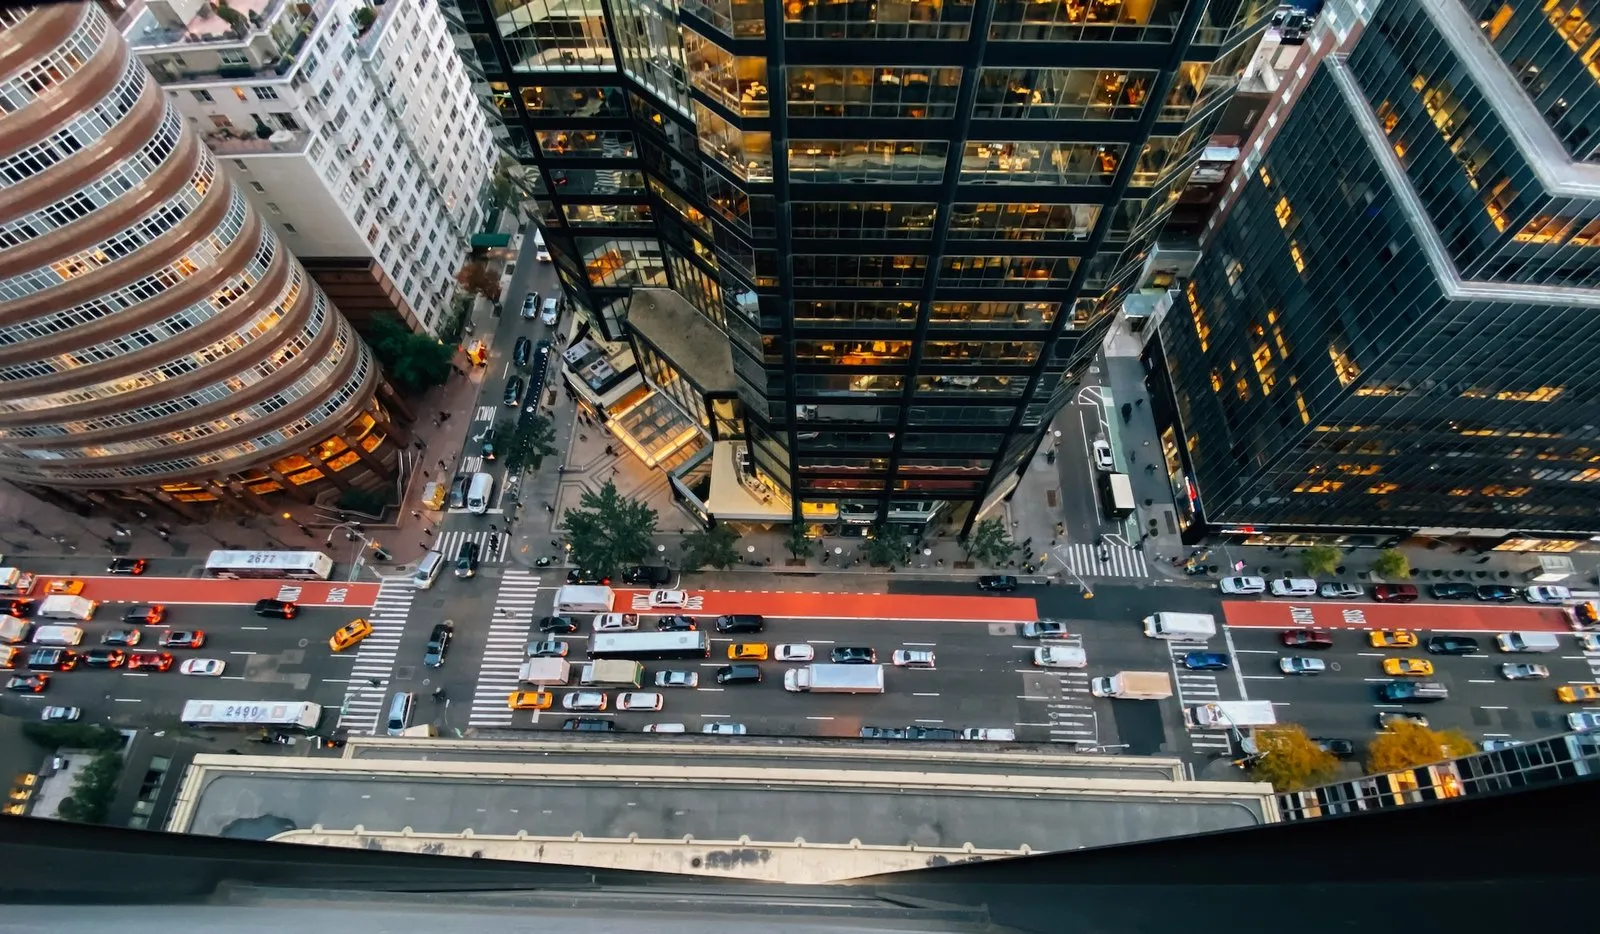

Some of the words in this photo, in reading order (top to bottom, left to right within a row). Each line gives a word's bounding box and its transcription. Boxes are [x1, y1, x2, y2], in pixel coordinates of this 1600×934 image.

[474, 406, 494, 421] ONLY
[460, 456, 480, 473] ONLY
[326, 588, 348, 603] BUS
[1289, 606, 1315, 624] ONLY
[1342, 609, 1367, 624] BUS
[226, 705, 258, 717] 2490
